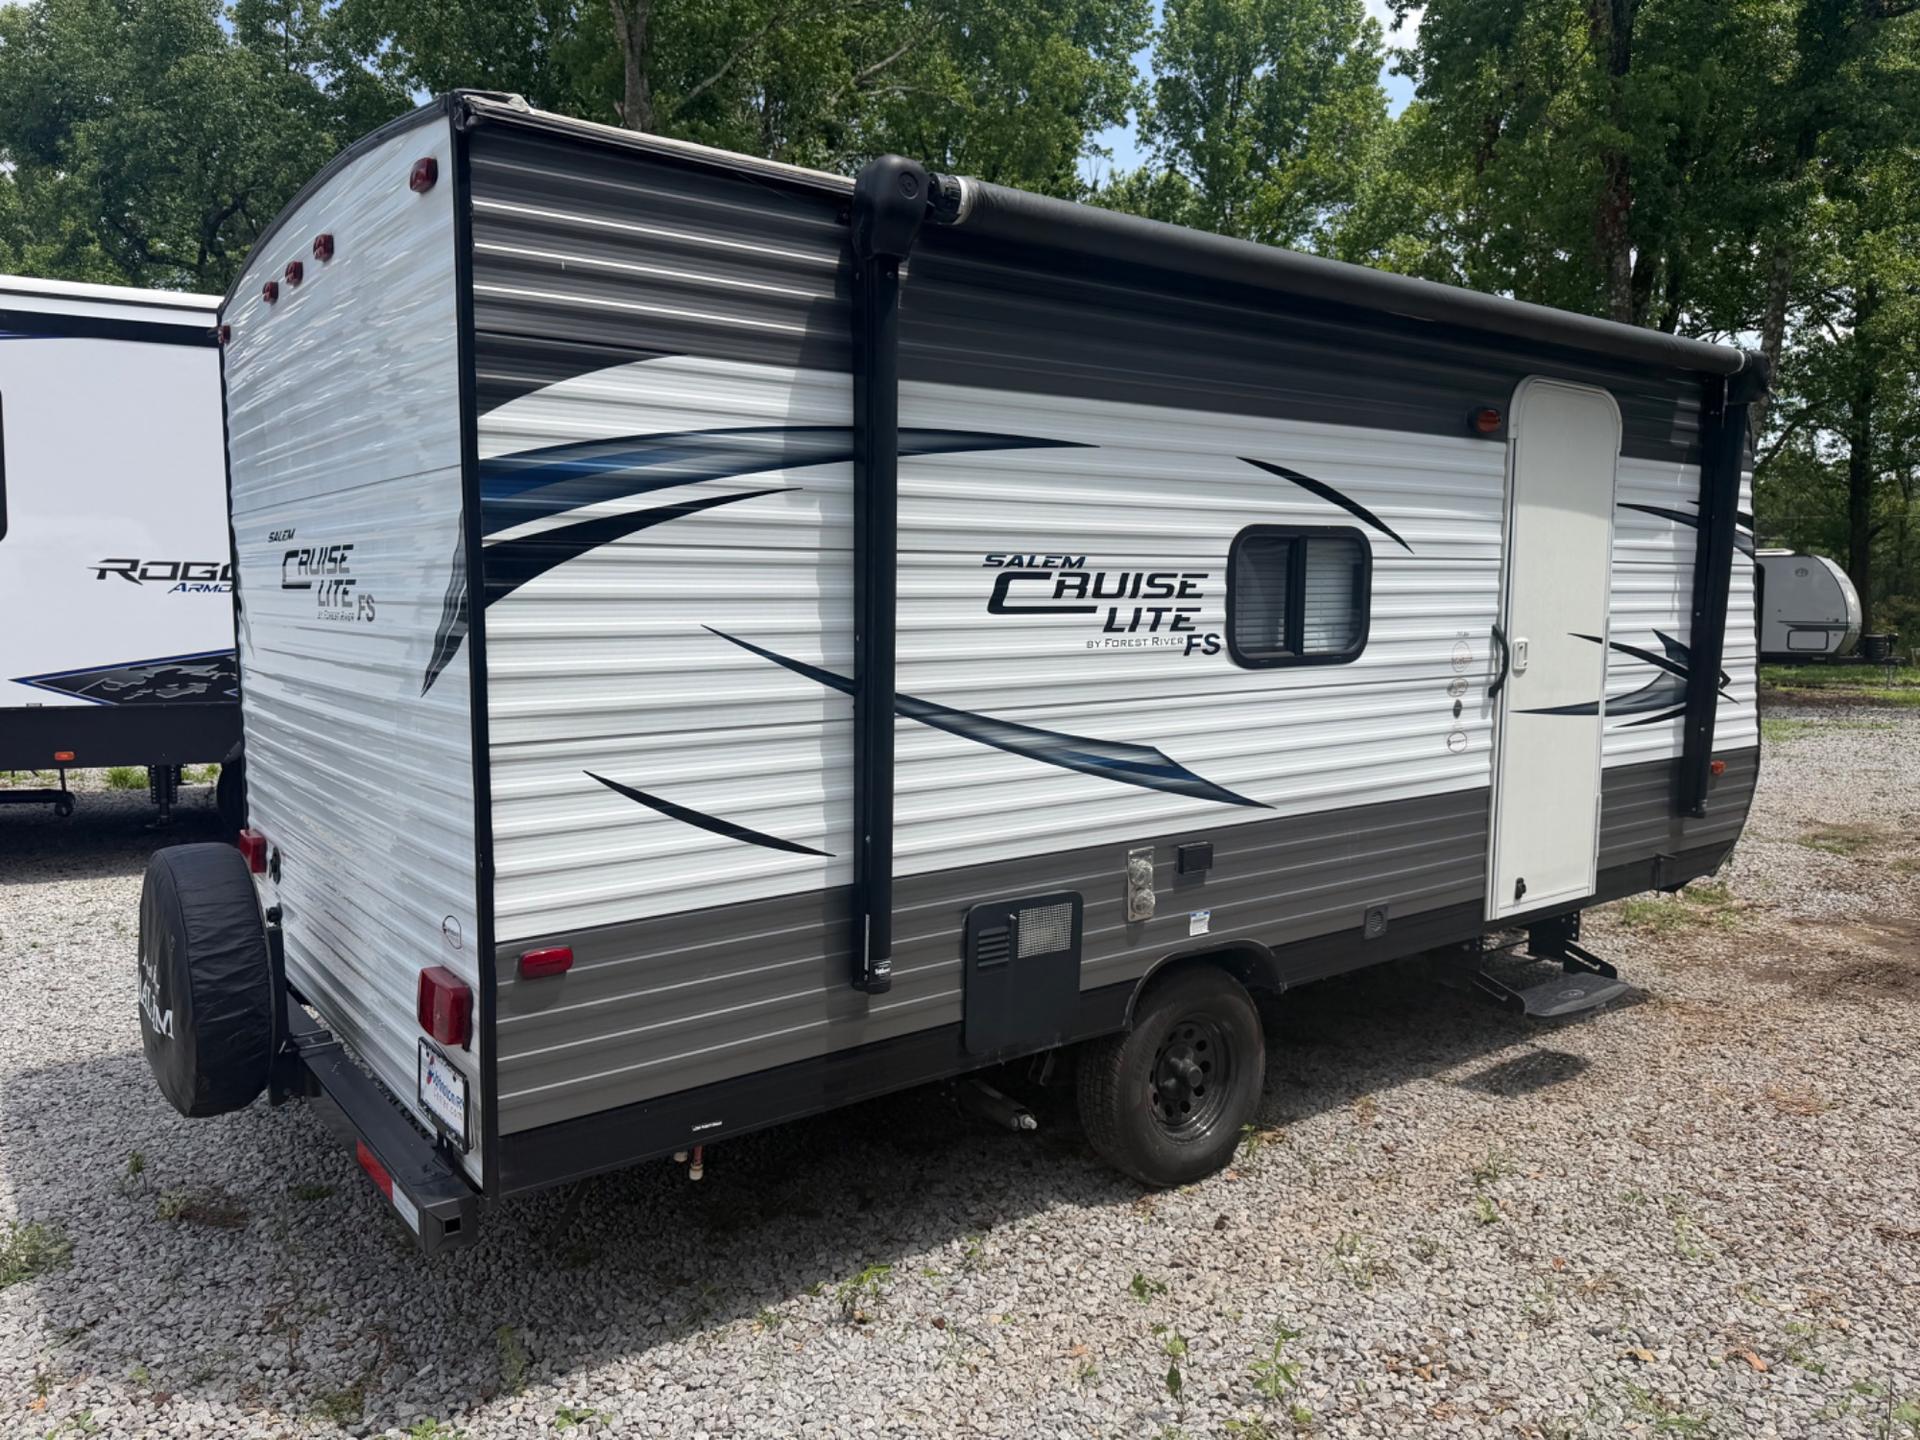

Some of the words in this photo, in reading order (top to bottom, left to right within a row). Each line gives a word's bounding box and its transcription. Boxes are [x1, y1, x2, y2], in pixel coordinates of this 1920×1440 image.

[267, 528, 296, 543] SALEM
[281, 544, 354, 589] CRUISE
[982, 554, 1087, 569] SALEM
[317, 579, 357, 608] LITE
[987, 571, 1209, 614] CRUISE
[357, 594, 376, 622] FS
[1102, 607, 1202, 633] LITE
[1086, 639, 1102, 649] BY
[1104, 638, 1149, 648] FOREST
[1151, 636, 1184, 646] RIVER
[1183, 633, 1221, 657] FS
